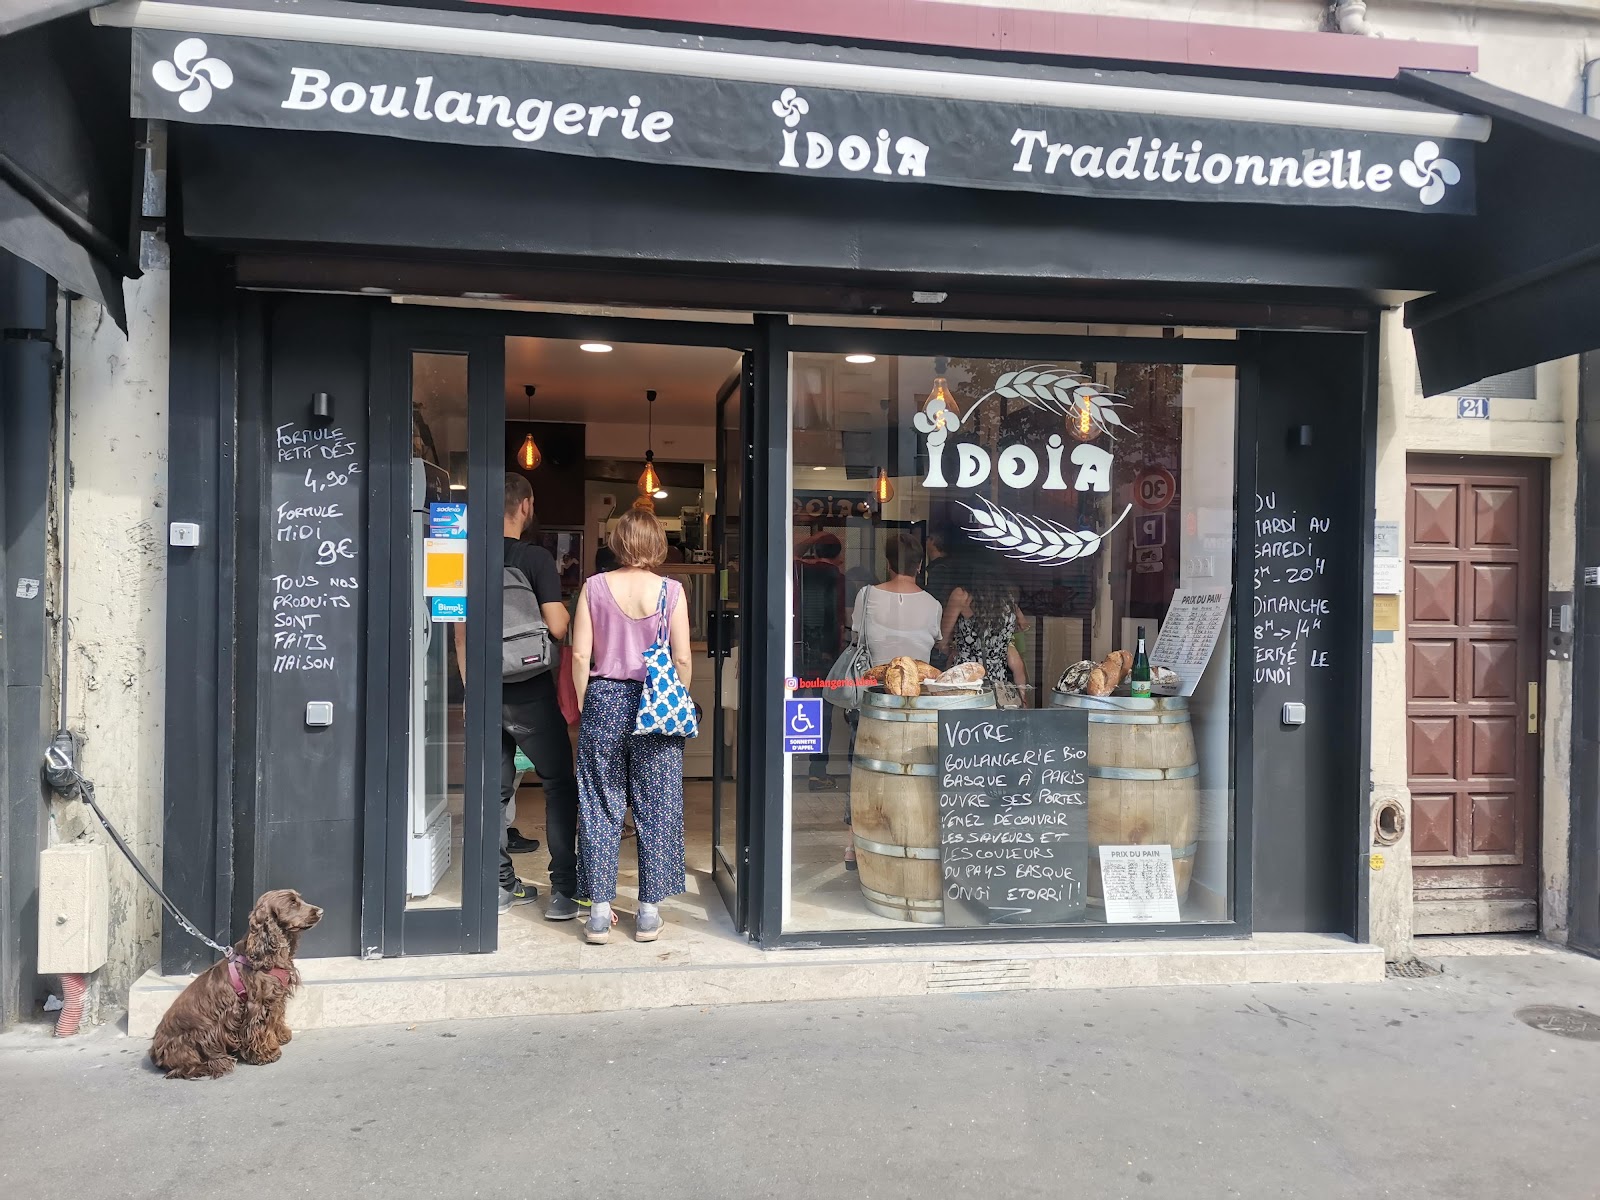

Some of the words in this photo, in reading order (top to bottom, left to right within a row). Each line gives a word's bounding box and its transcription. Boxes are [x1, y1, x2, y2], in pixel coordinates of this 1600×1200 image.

[281, 66, 674, 143] Boulangerie
[1010, 126, 1394, 193] Traditionnelle
[1462, 399, 1485, 418] 21
[276, 422, 346, 448] FORMULE
[304, 463, 362, 493] 4,90€
[277, 501, 343, 524] FORMULE
[1309, 516, 1330, 533] AU
[316, 538, 358, 566] 9€
[272, 574, 320, 593] TOUS
[330, 577, 359, 589] NOS
[274, 612, 321, 630] SONT
[1310, 649, 1330, 667] LE
[945, 720, 1013, 748] VOTRE
[943, 774, 1007, 788] BASQUE
[940, 794, 990, 808] OUVRE
[1001, 793, 1032, 807] SES
[942, 832, 964, 845] LES
[966, 832, 1035, 844] SAVEURS
[1040, 832, 1070, 843] ET
[944, 847, 973, 864] LES
[976, 846, 1054, 860] COULEURS
[1142, 850, 1160, 858] PAIN
[945, 866, 960, 880] DU
[966, 864, 1006, 880] PAYS
[1016, 863, 1076, 882] BASQUE
